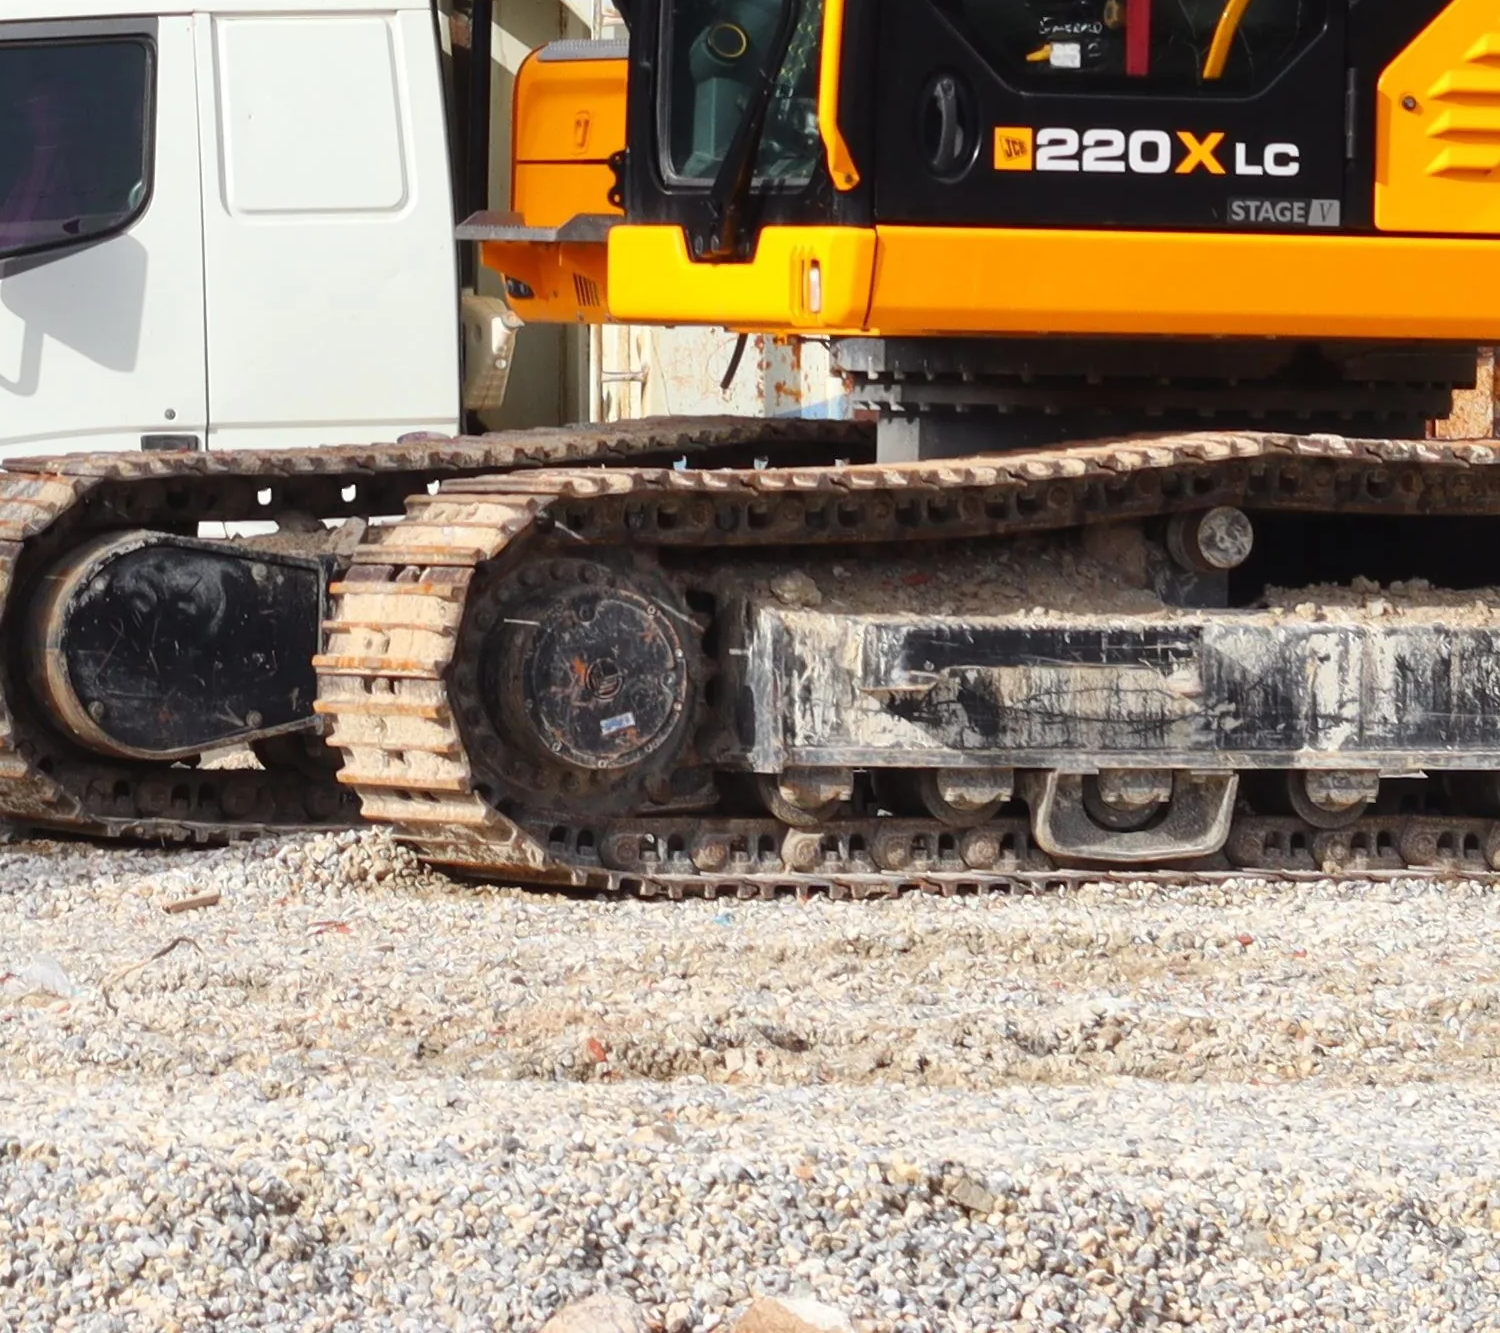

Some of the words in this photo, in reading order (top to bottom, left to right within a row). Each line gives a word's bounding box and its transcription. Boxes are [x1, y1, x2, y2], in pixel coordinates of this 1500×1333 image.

[1035, 127, 1227, 175] 220X
[1235, 142, 1301, 176] LC
[1230, 200, 1306, 223] STAGE
